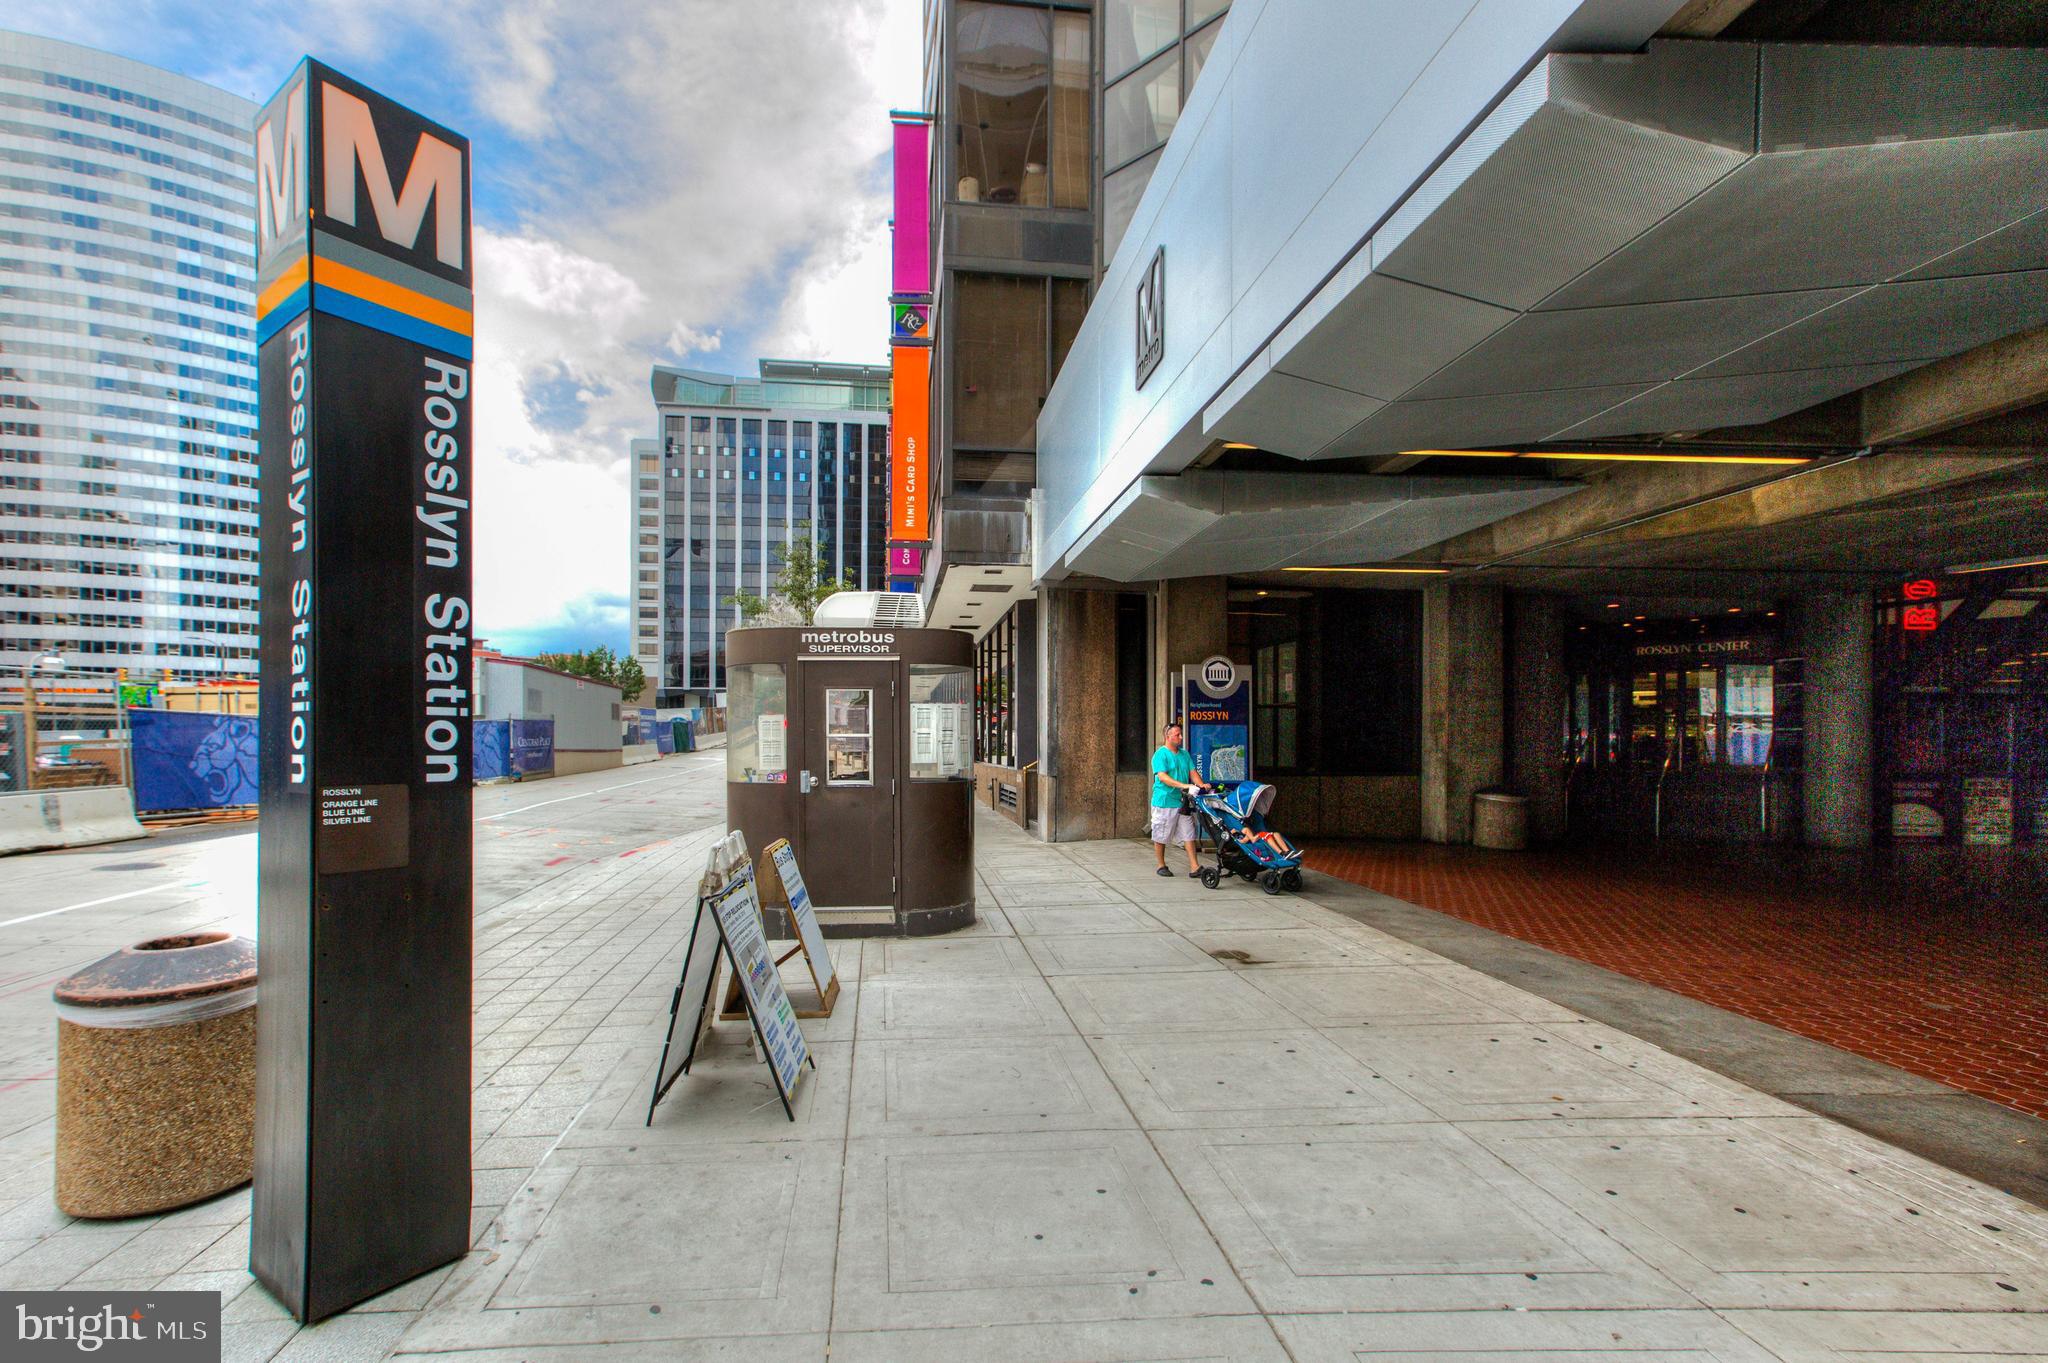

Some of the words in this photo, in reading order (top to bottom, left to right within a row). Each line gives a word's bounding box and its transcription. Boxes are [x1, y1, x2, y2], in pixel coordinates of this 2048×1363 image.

[257, 80, 305, 254] M
[321, 80, 462, 271] M
[1137, 338, 1160, 379] metro
[289, 321, 311, 552] Rosslyn
[416, 356, 469, 569] Rosslyn
[801, 630, 895, 643] metrobus
[808, 644, 890, 653] SUPERVISOR
[1636, 644, 1691, 656] ROSSLYN
[1697, 640, 1750, 653] CENTER
[290, 579, 311, 784] Station
[424, 593, 470, 783] Station
[1190, 711, 1229, 720] ROSSLYN
[322, 788, 361, 796] ROSSLYN
[322, 800, 359, 808] ORANGE
[322, 817, 351, 825] SILVER
